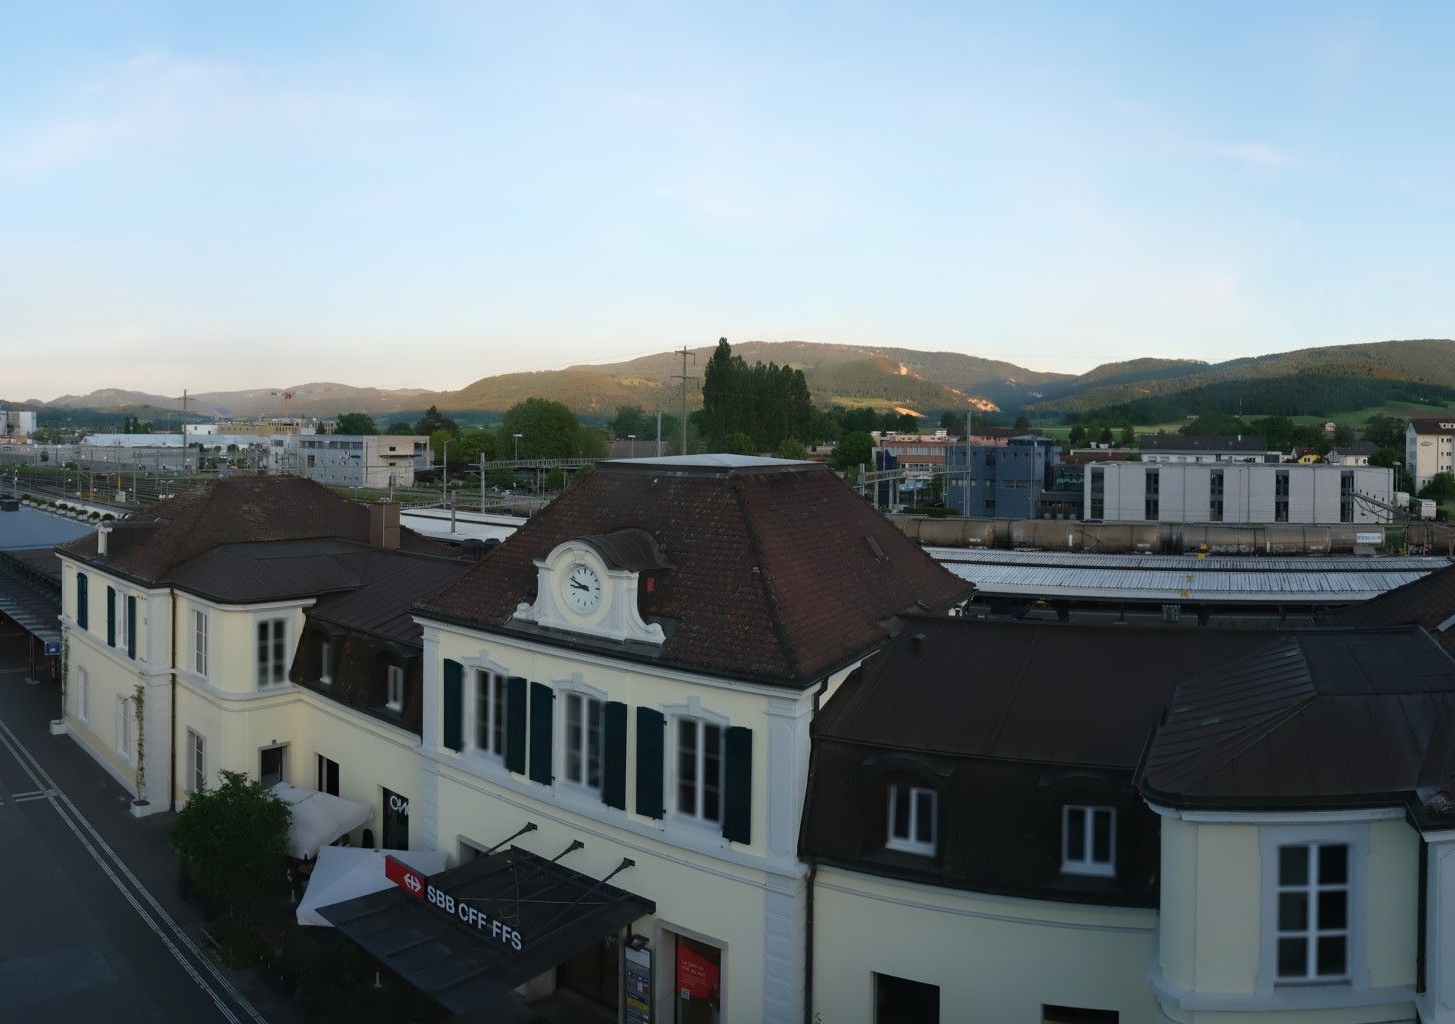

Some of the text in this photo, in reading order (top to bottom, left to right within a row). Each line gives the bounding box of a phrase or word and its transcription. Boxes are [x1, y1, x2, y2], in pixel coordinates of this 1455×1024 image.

[426, 885, 522, 951] SBB CFF FFS
